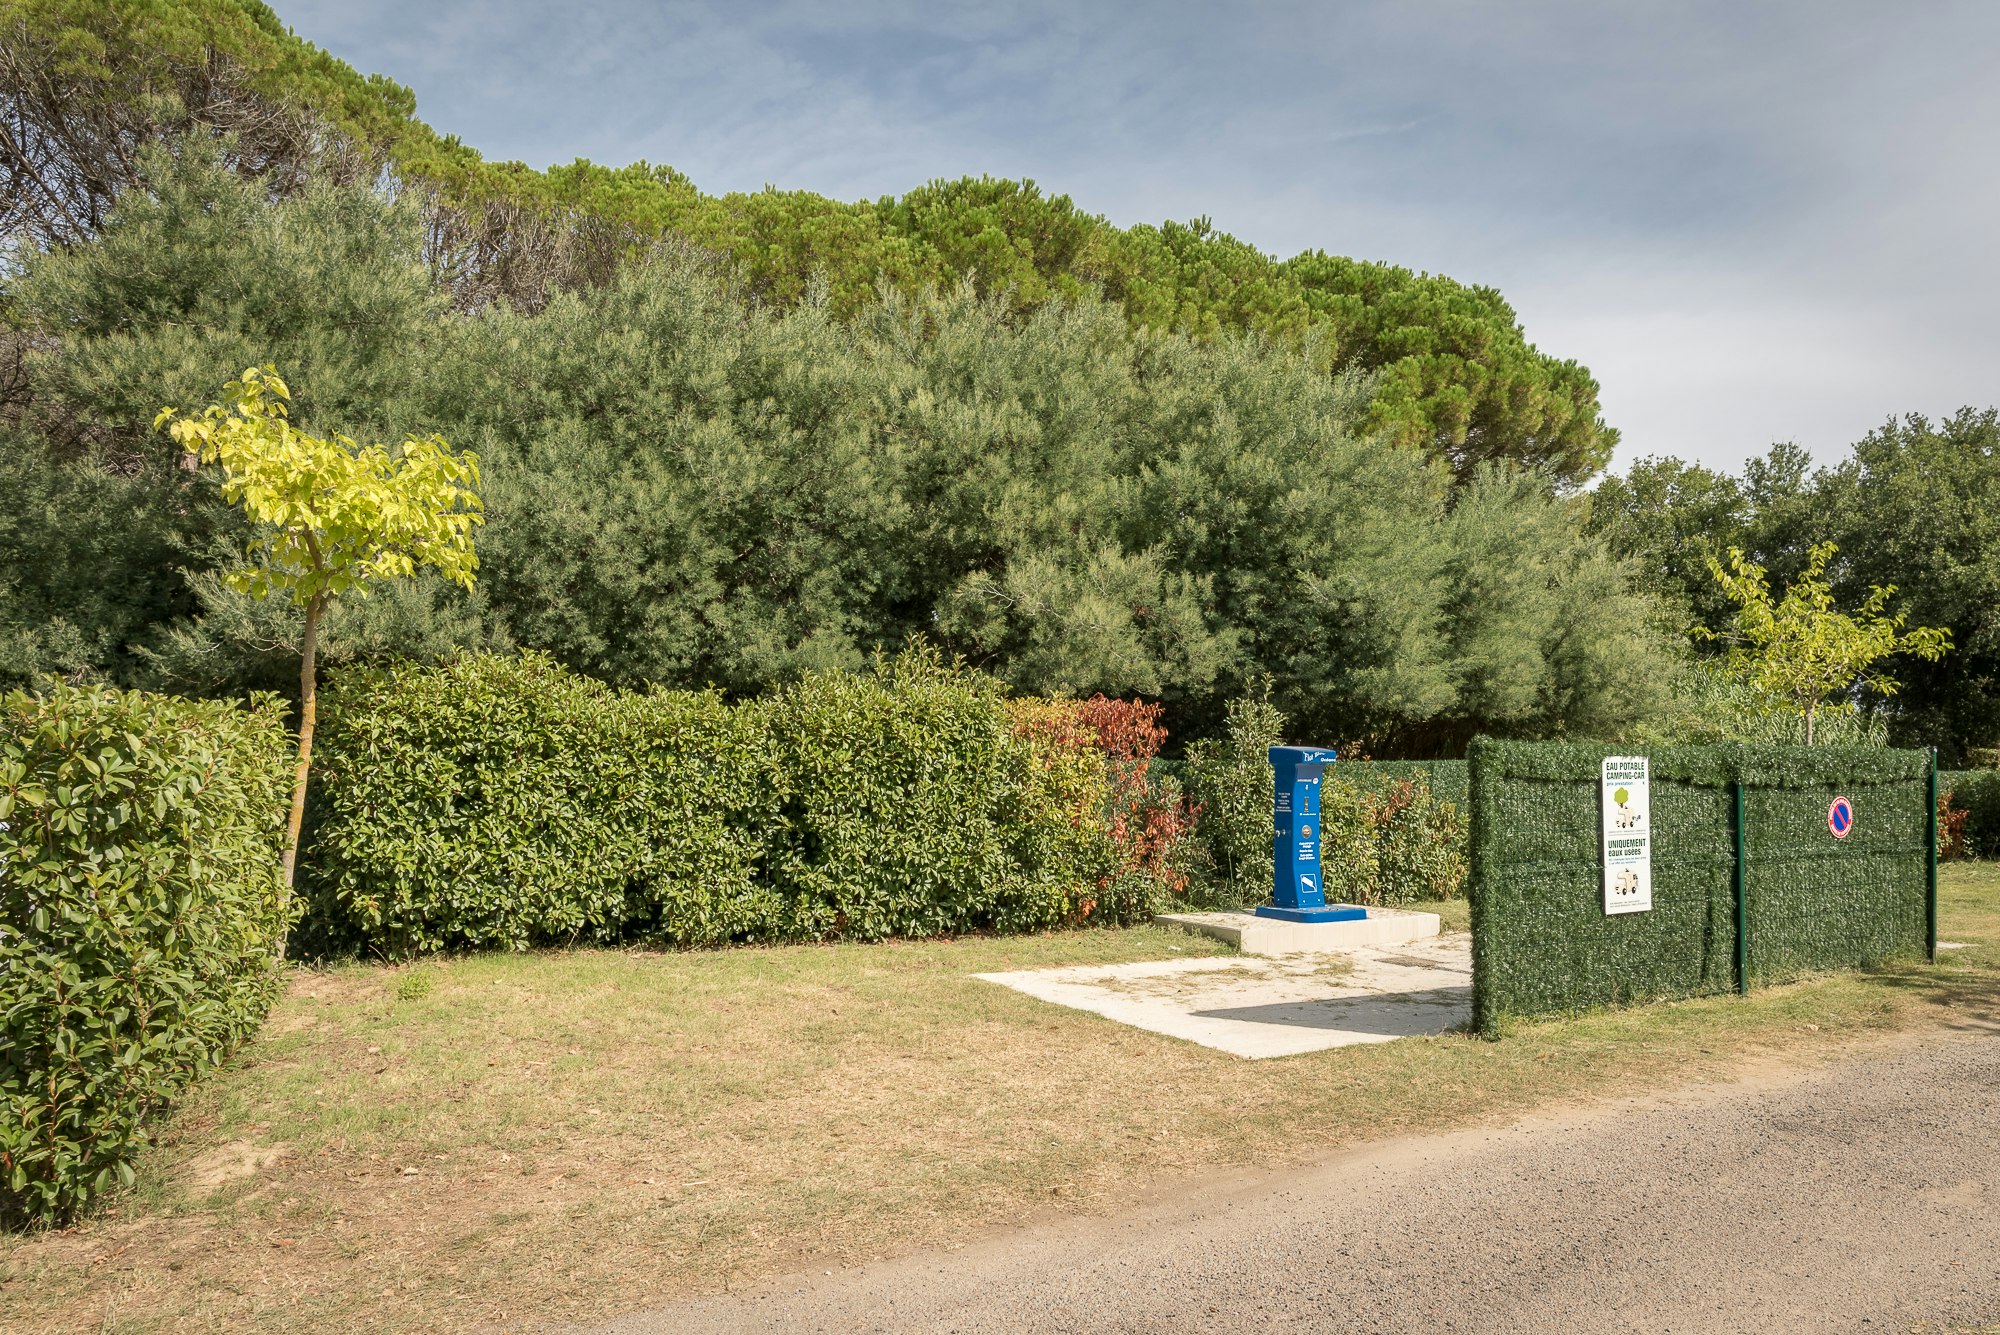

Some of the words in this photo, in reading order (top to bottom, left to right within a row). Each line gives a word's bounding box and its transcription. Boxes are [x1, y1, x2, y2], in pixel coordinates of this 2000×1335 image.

[1606, 763, 1618, 771] EAU
[1619, 762, 1645, 771] POTABLE
[1606, 771, 1645, 780] CAMPING-CAR
[1608, 838, 1646, 849] UNIQUEMENT
[1608, 849, 1623, 857] eaux
